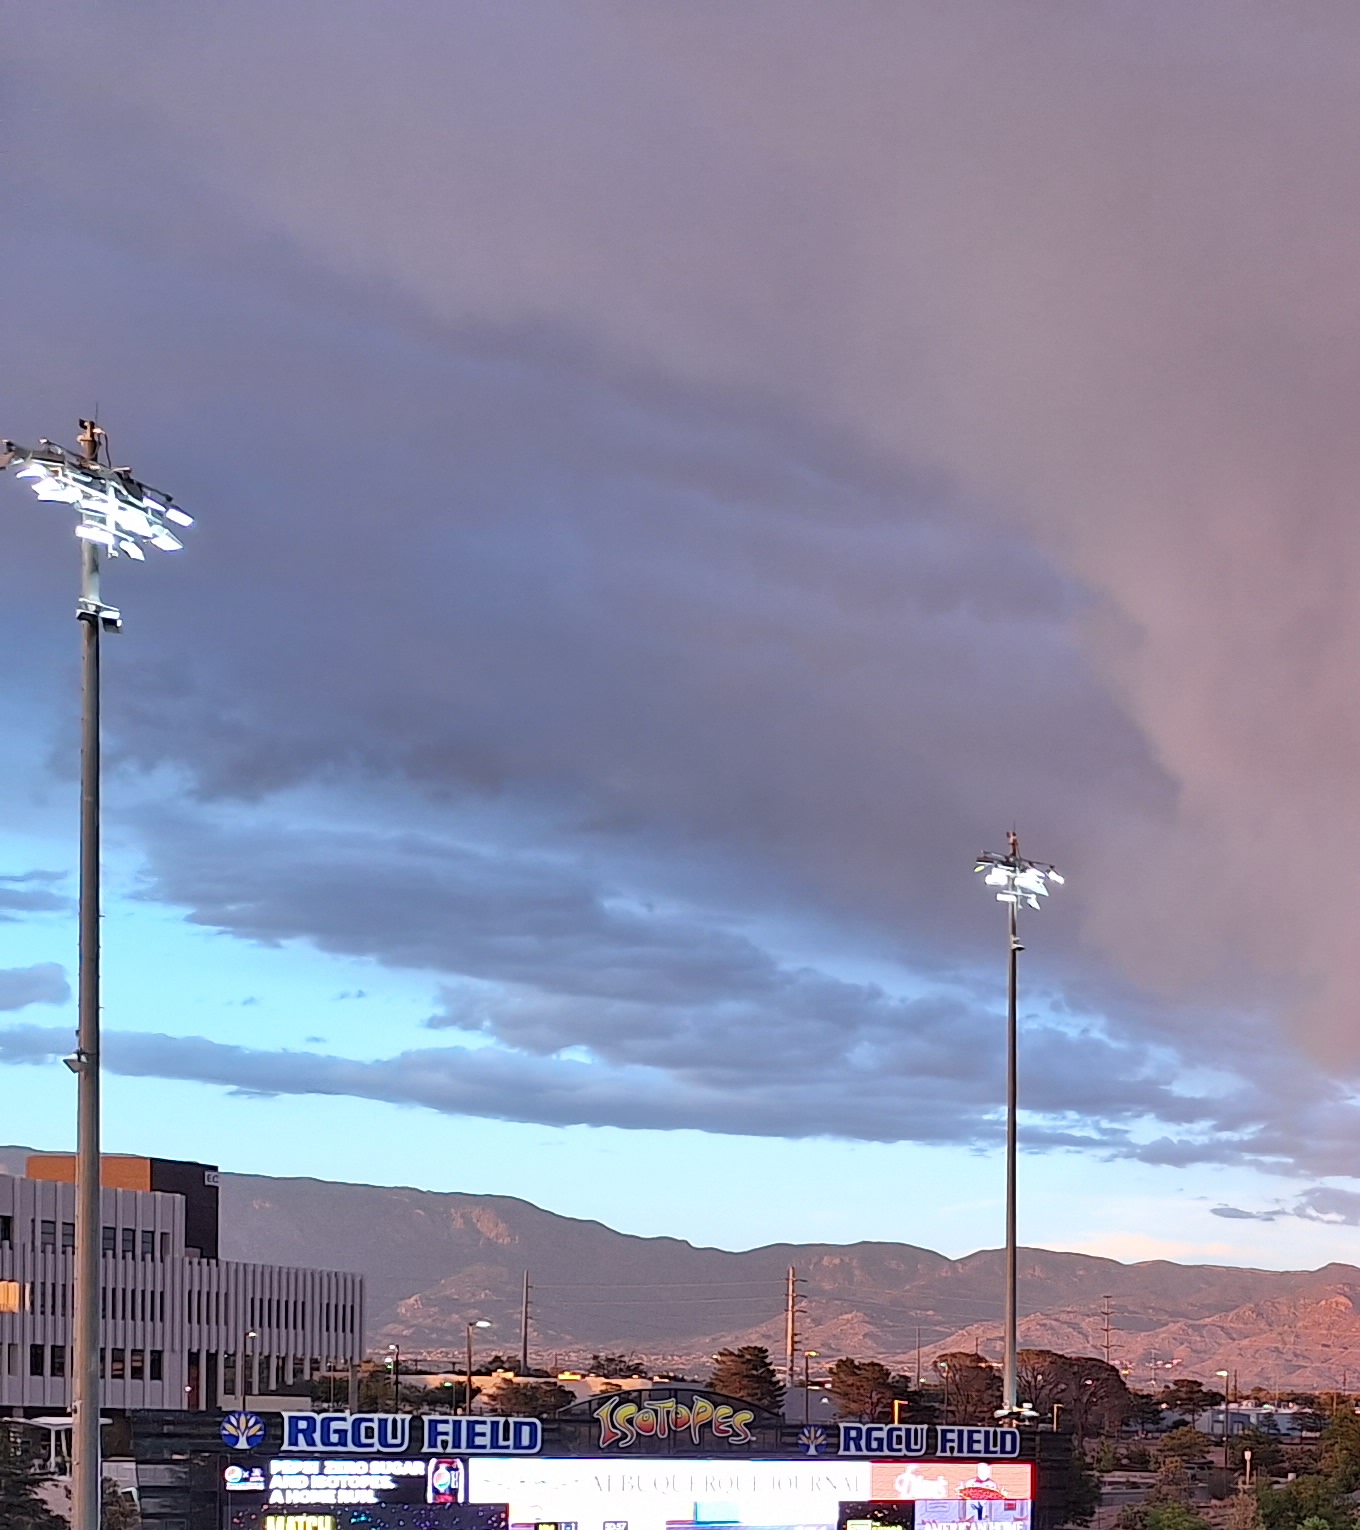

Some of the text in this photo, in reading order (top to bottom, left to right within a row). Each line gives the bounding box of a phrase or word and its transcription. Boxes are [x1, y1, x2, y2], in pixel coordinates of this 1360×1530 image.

[285, 1413, 541, 1453] RGCU FIELD
[593, 1395, 754, 1449] ISOTOPES
[840, 1424, 1020, 1458] RGCU FIELD
